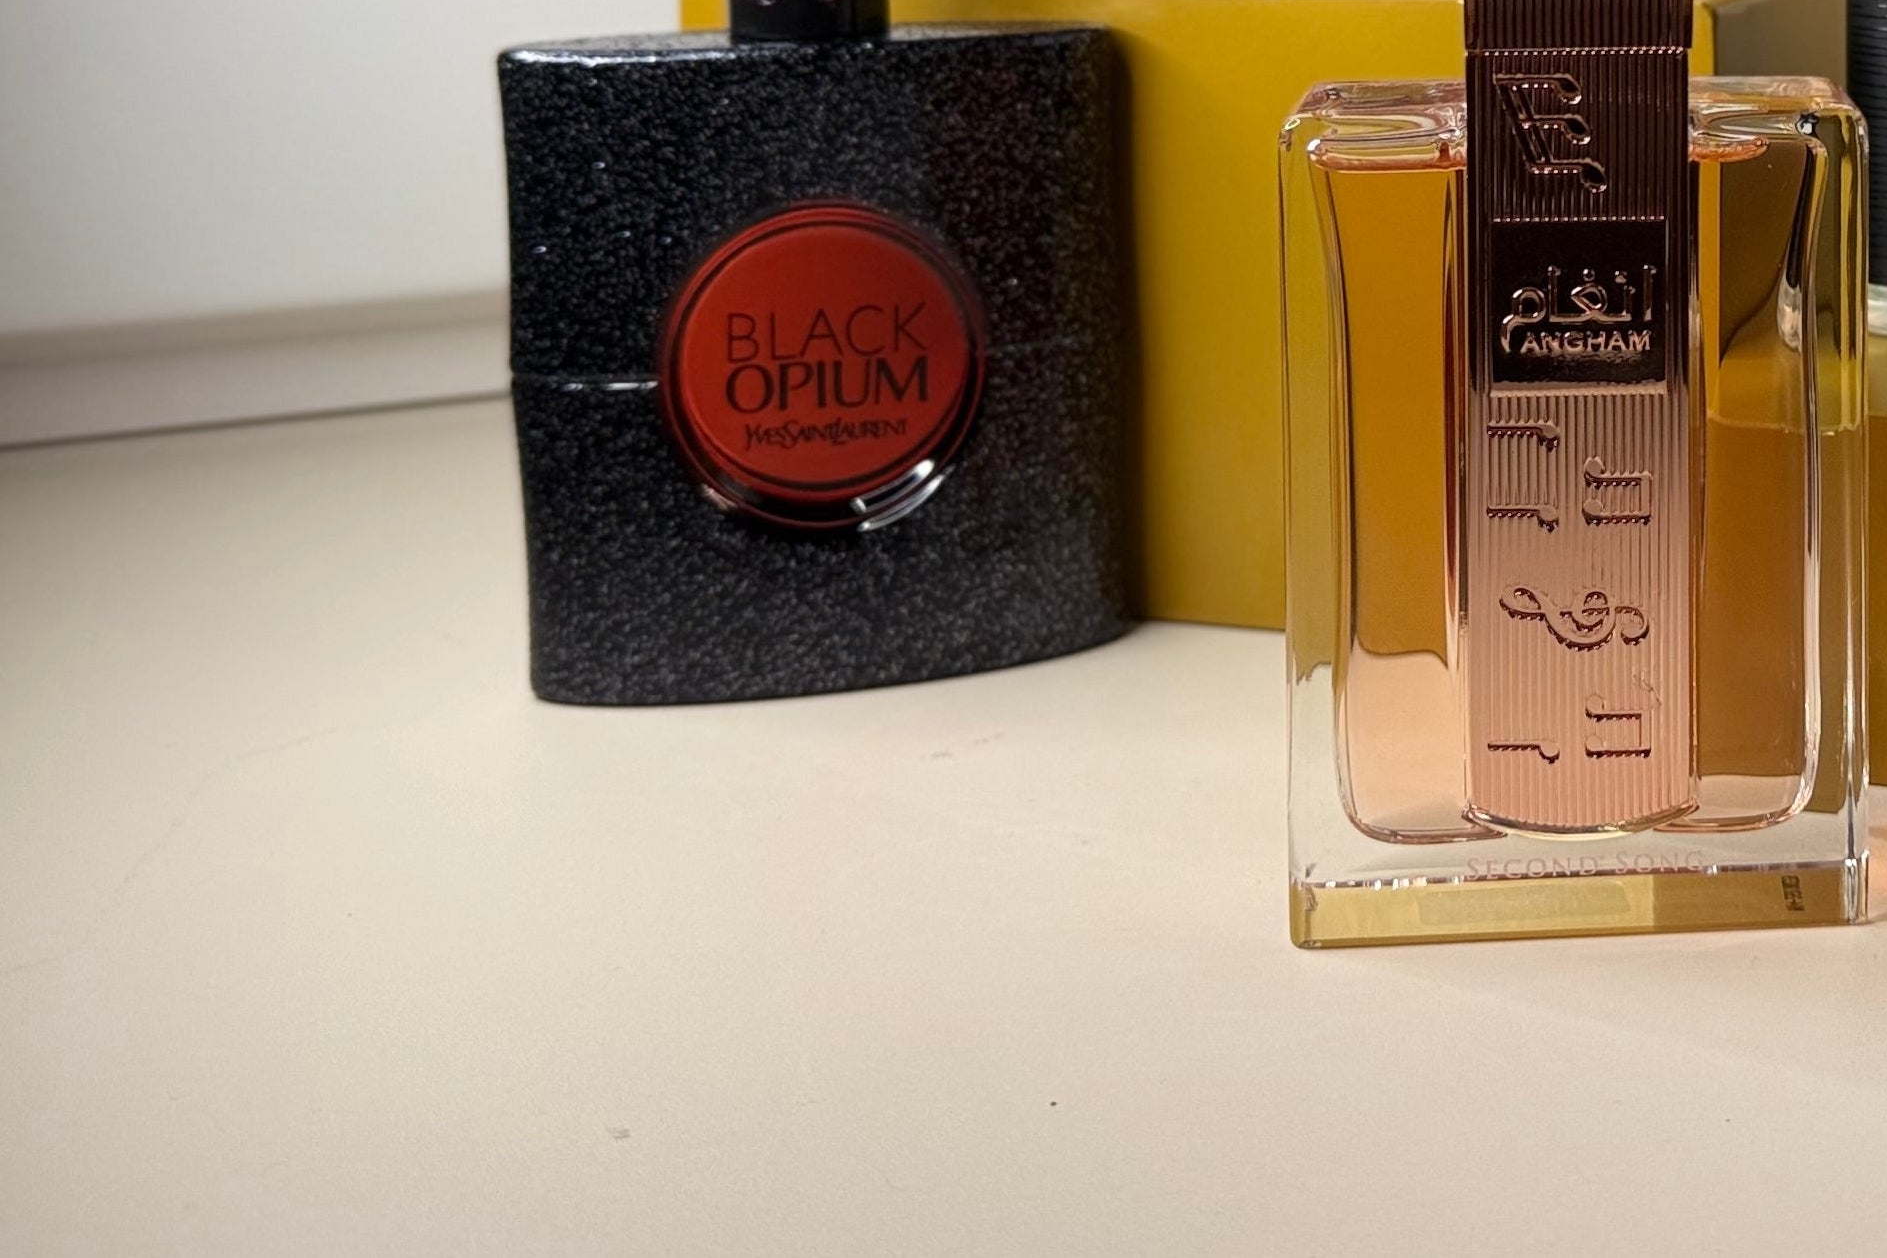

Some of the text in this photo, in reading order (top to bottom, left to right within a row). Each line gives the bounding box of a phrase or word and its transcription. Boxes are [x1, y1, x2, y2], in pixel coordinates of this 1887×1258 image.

[726, 301, 927, 364] BLACK
[1520, 330, 1651, 354] ANGHAM
[724, 355, 929, 414] OPIUM
[1466, 849, 1707, 882] SECOND SONG
